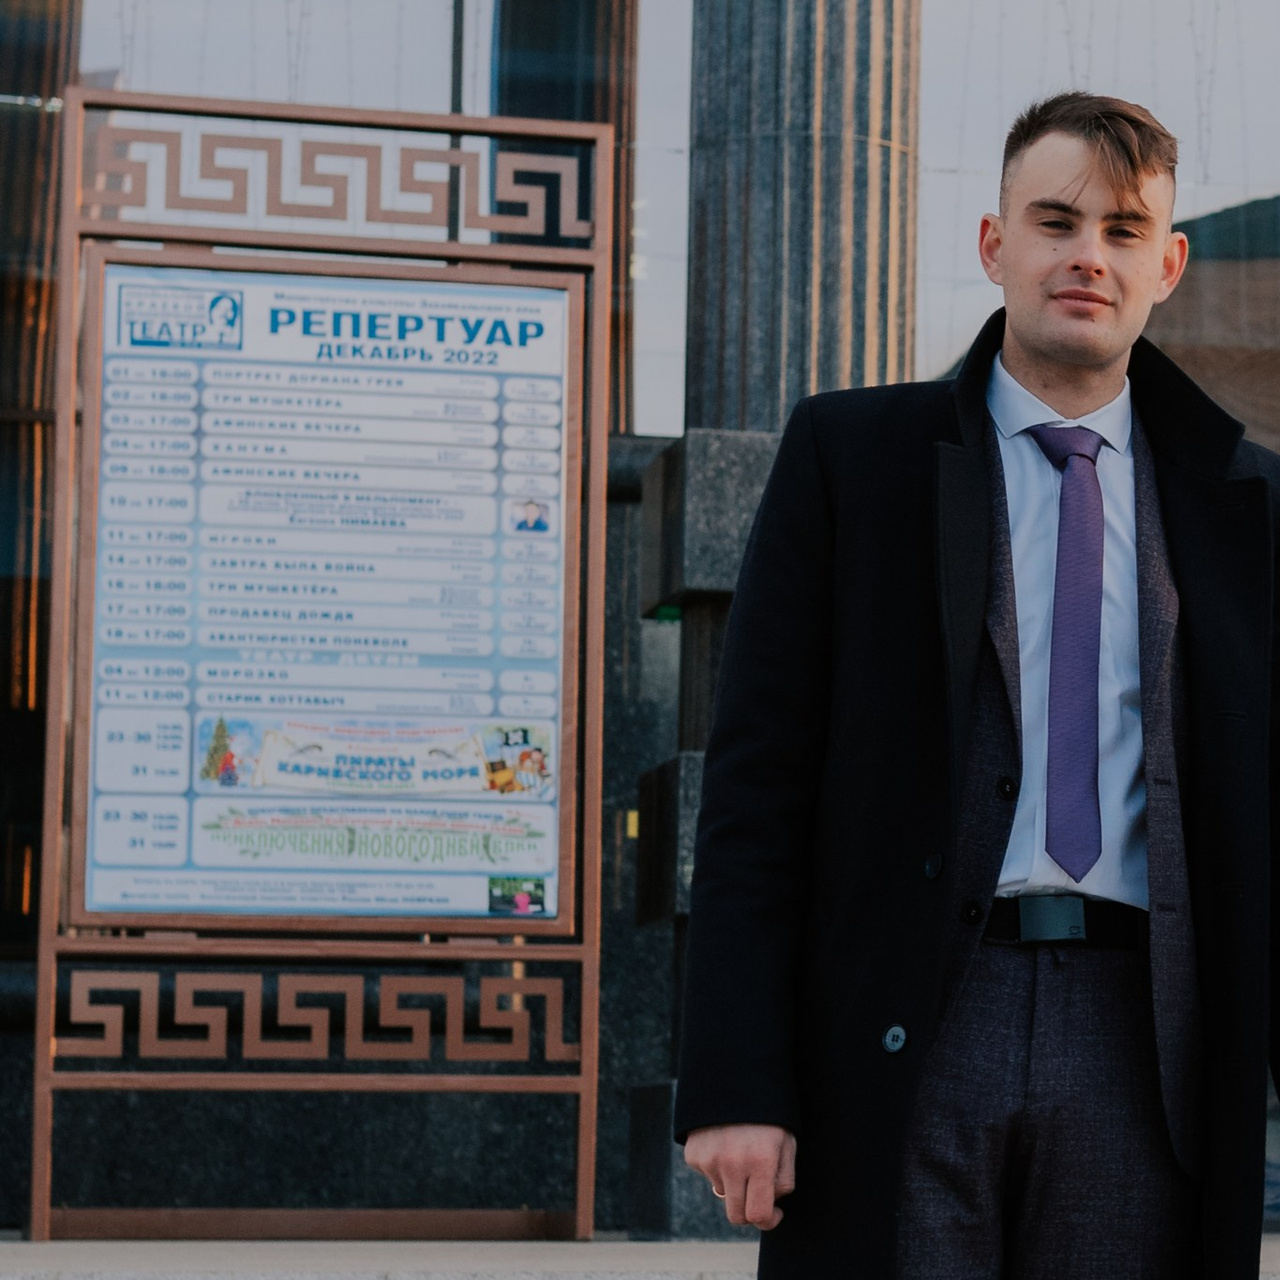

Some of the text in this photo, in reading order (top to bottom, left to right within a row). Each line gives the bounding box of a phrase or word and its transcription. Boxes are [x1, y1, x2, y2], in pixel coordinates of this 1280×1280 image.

[269, 308, 545, 347] РЕПЕРТУАР
[316, 344, 499, 365] ДЕКАБРЬ 2022
[213, 371, 281, 381] ПОРТРЕТ
[214, 395, 242, 403] ТРИ
[210, 559, 266, 569] ЗАВТРА
[209, 583, 237, 592] ТРИ
[208, 669, 289, 679] МОРОЗКО
[208, 693, 263, 703] СТАРИК
[335, 755, 416, 767] ПИРАТЫ
